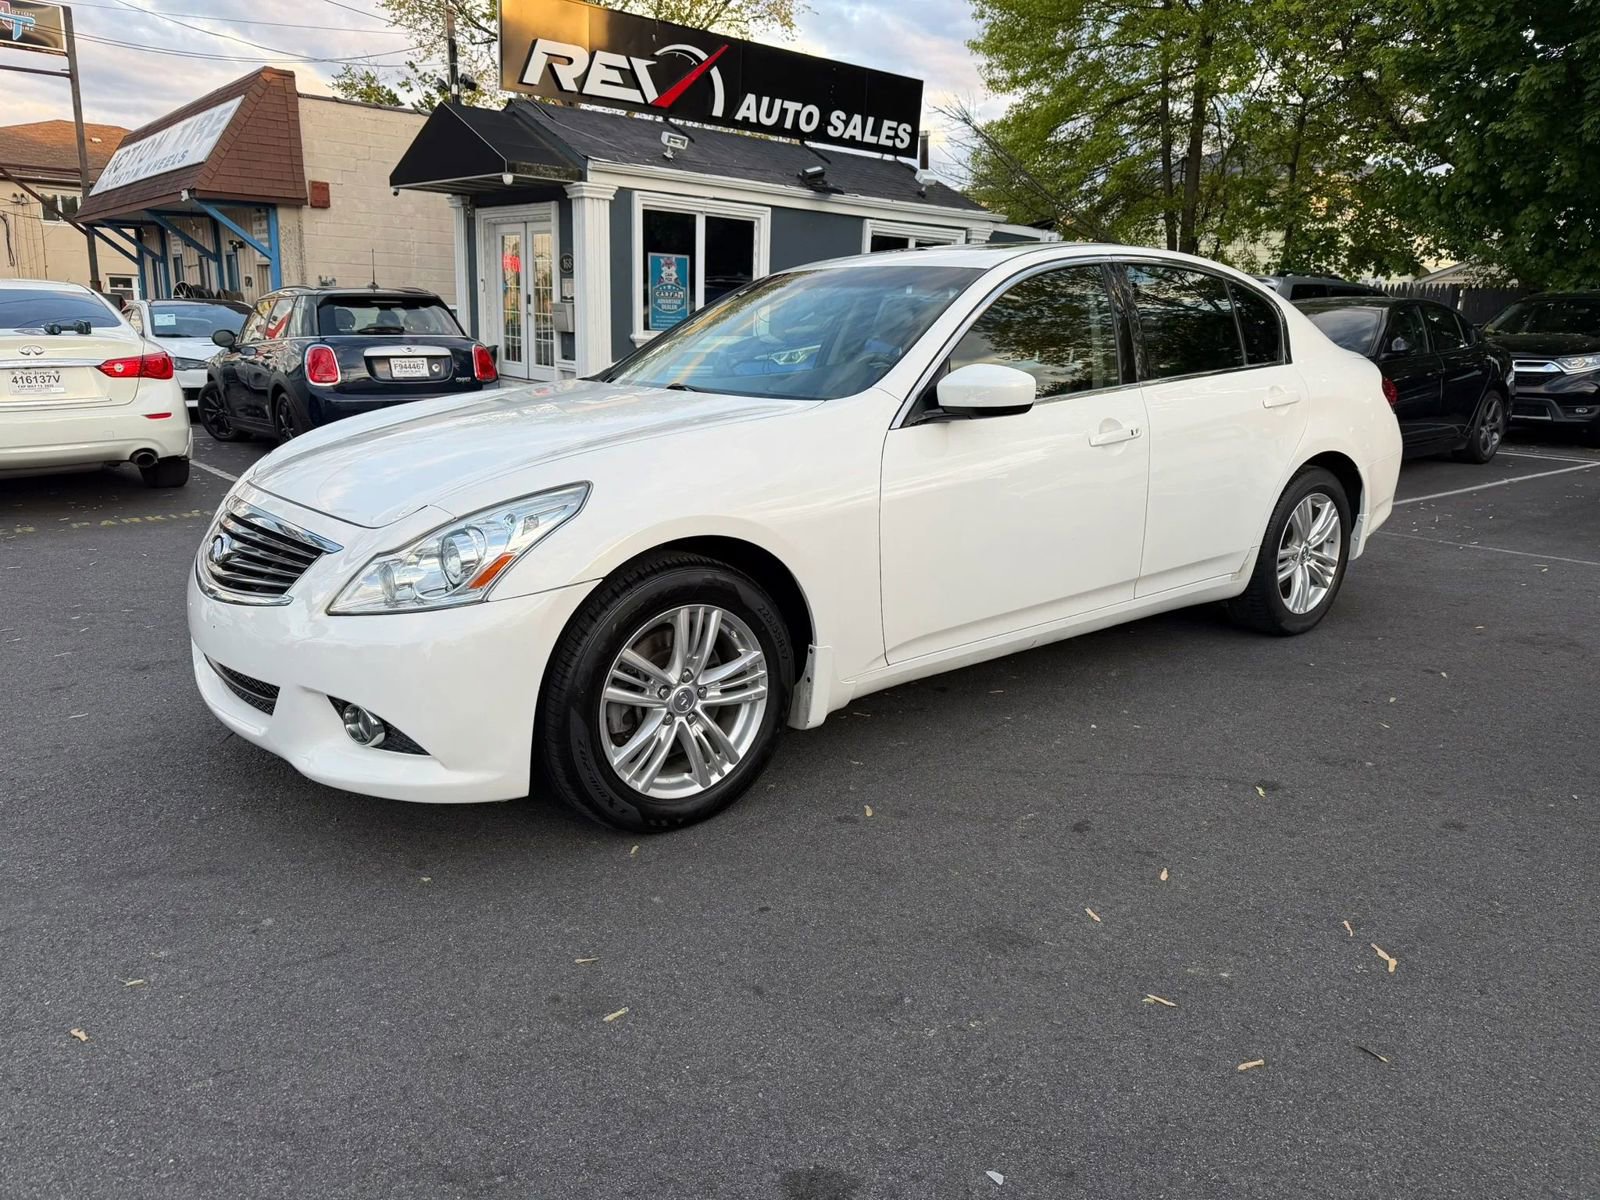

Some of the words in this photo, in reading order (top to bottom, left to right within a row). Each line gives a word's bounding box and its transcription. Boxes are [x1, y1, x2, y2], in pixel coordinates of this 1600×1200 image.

[519, 37, 729, 109] REV
[106, 128, 170, 176] ACTION
[174, 106, 235, 151] TIRE
[735, 92, 820, 133] AUTO
[827, 110, 912, 149] SALES
[143, 150, 189, 177] WHEELS
[12, 375, 61, 384] 416137V
[394, 362, 424, 370] F944467
